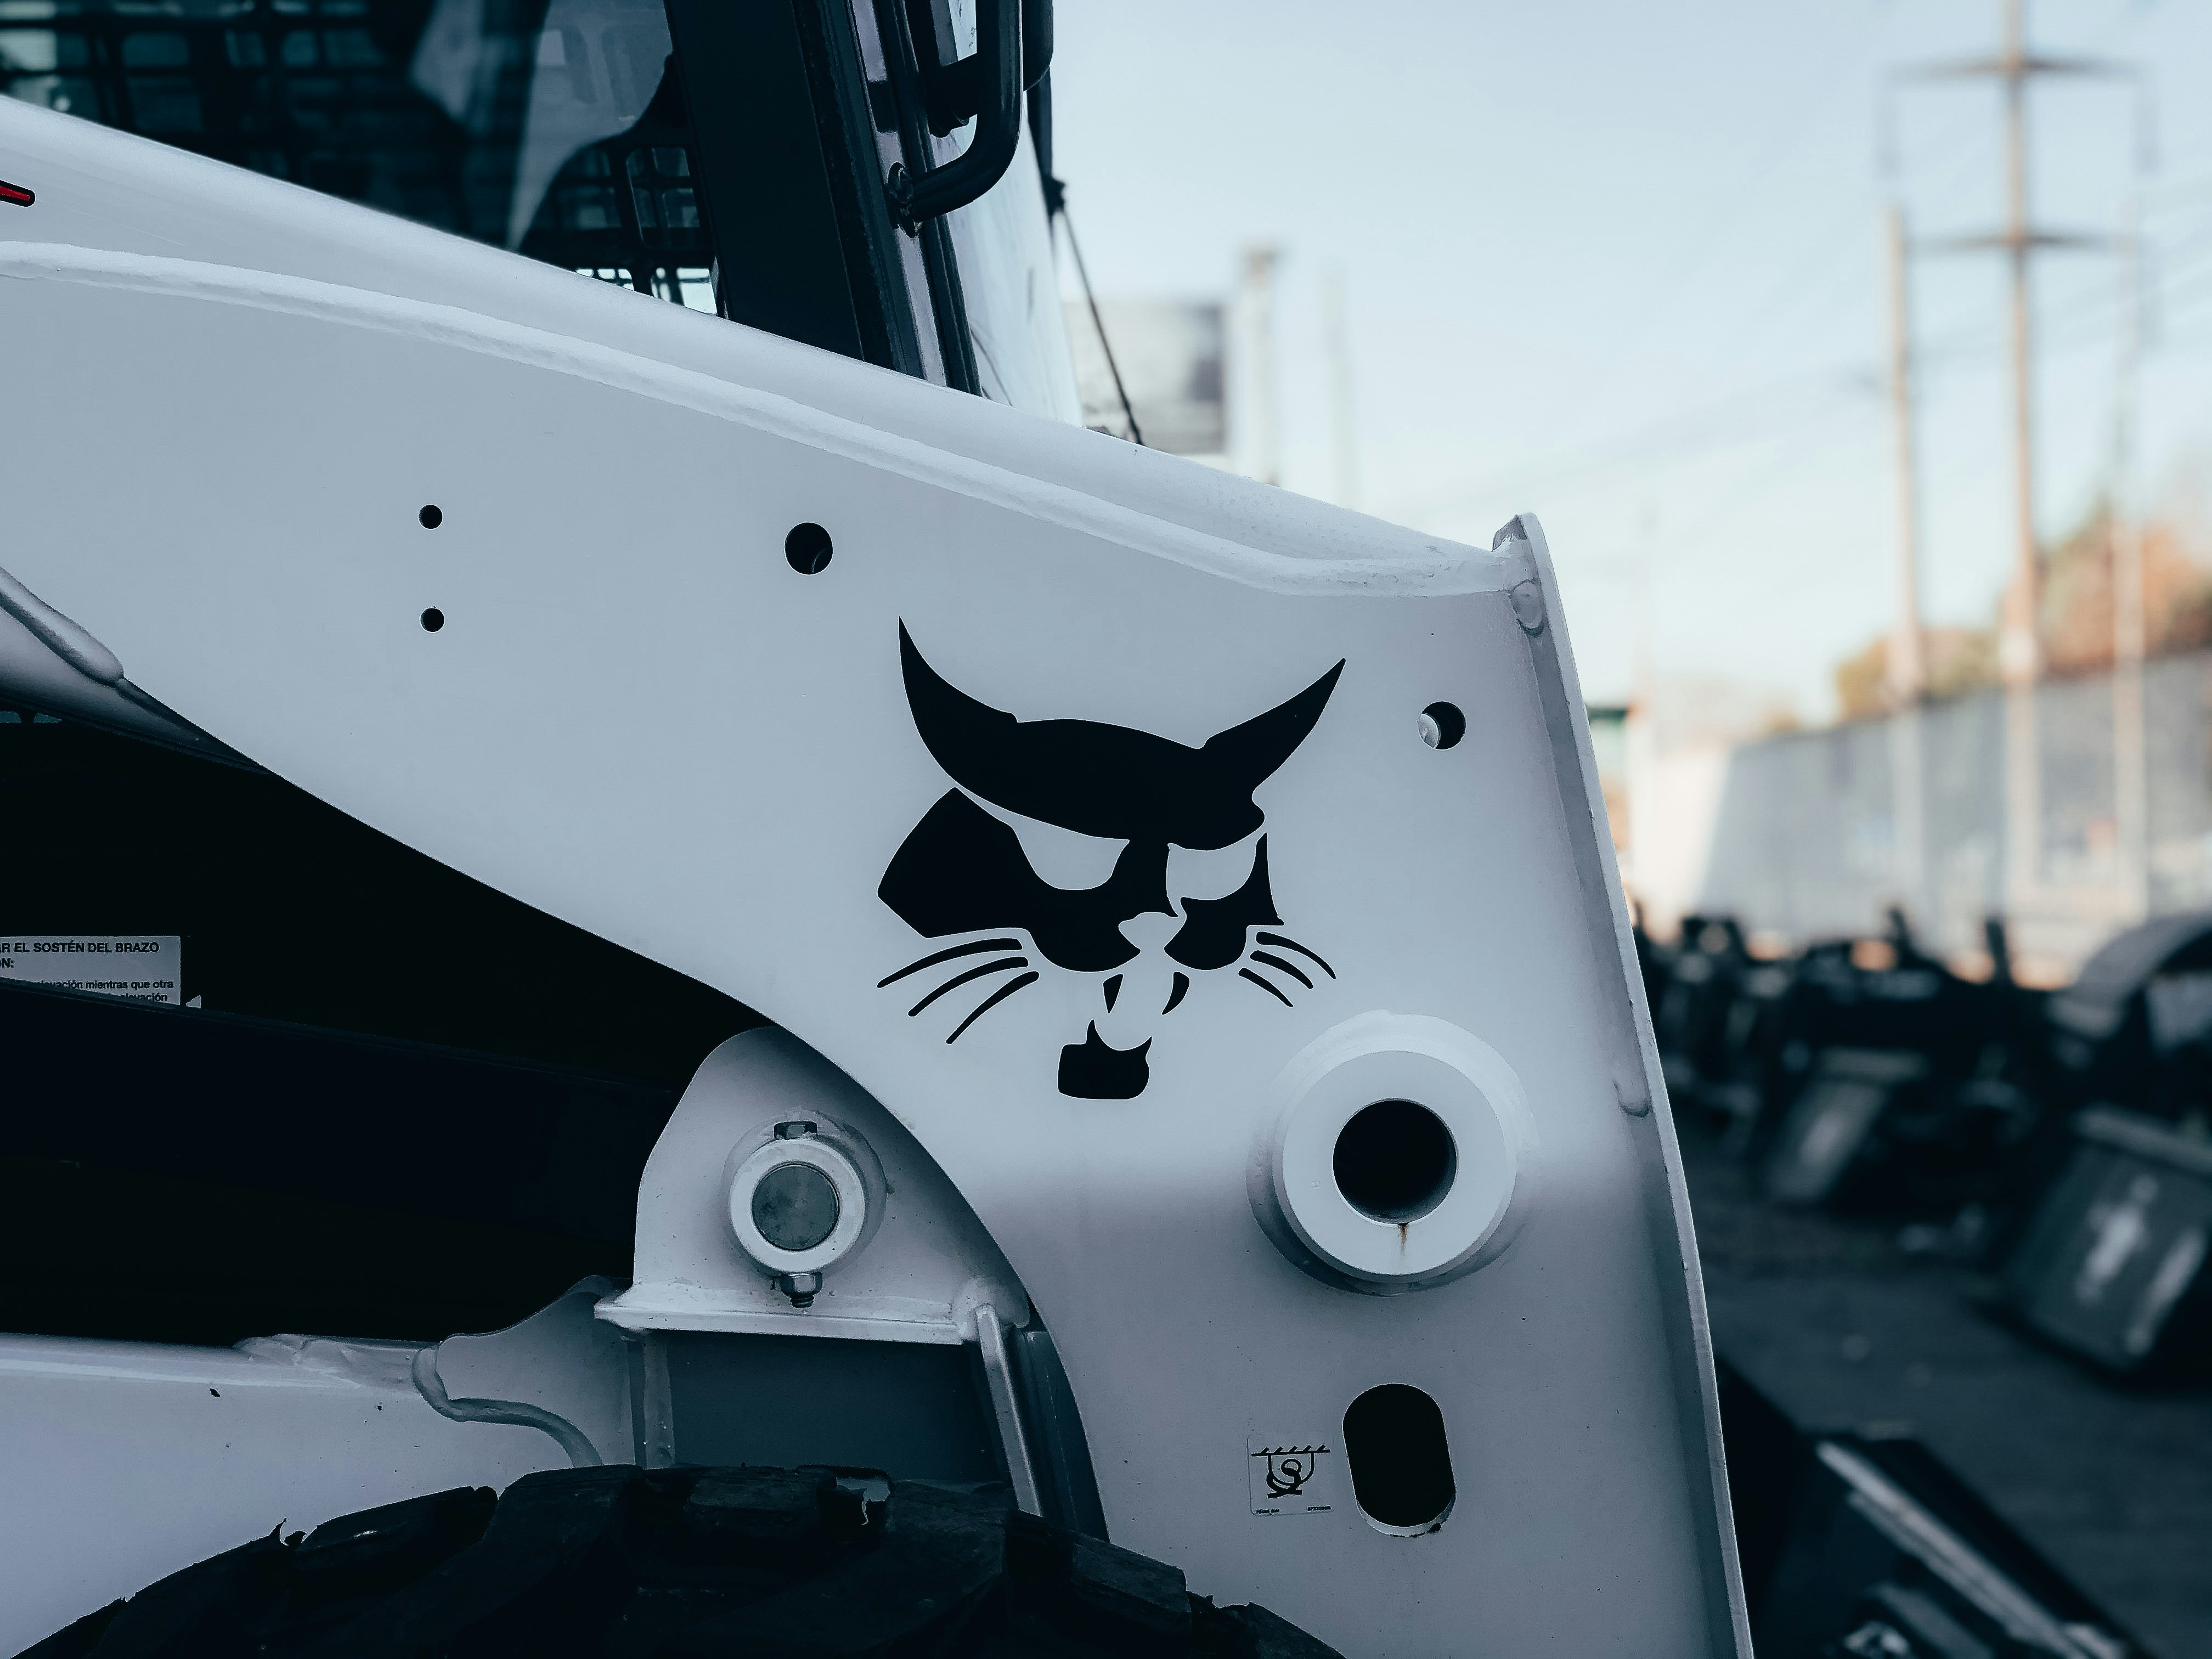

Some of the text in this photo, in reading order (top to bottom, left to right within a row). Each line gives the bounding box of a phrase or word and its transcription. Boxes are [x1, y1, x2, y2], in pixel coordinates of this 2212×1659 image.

[0, 939, 160, 953] R EL SOSTÉN DEL BRAZO
[0, 958, 14, 968] N:
[36, 980, 174, 991] ación mientras que otra
[121, 992, 167, 1002] vación
